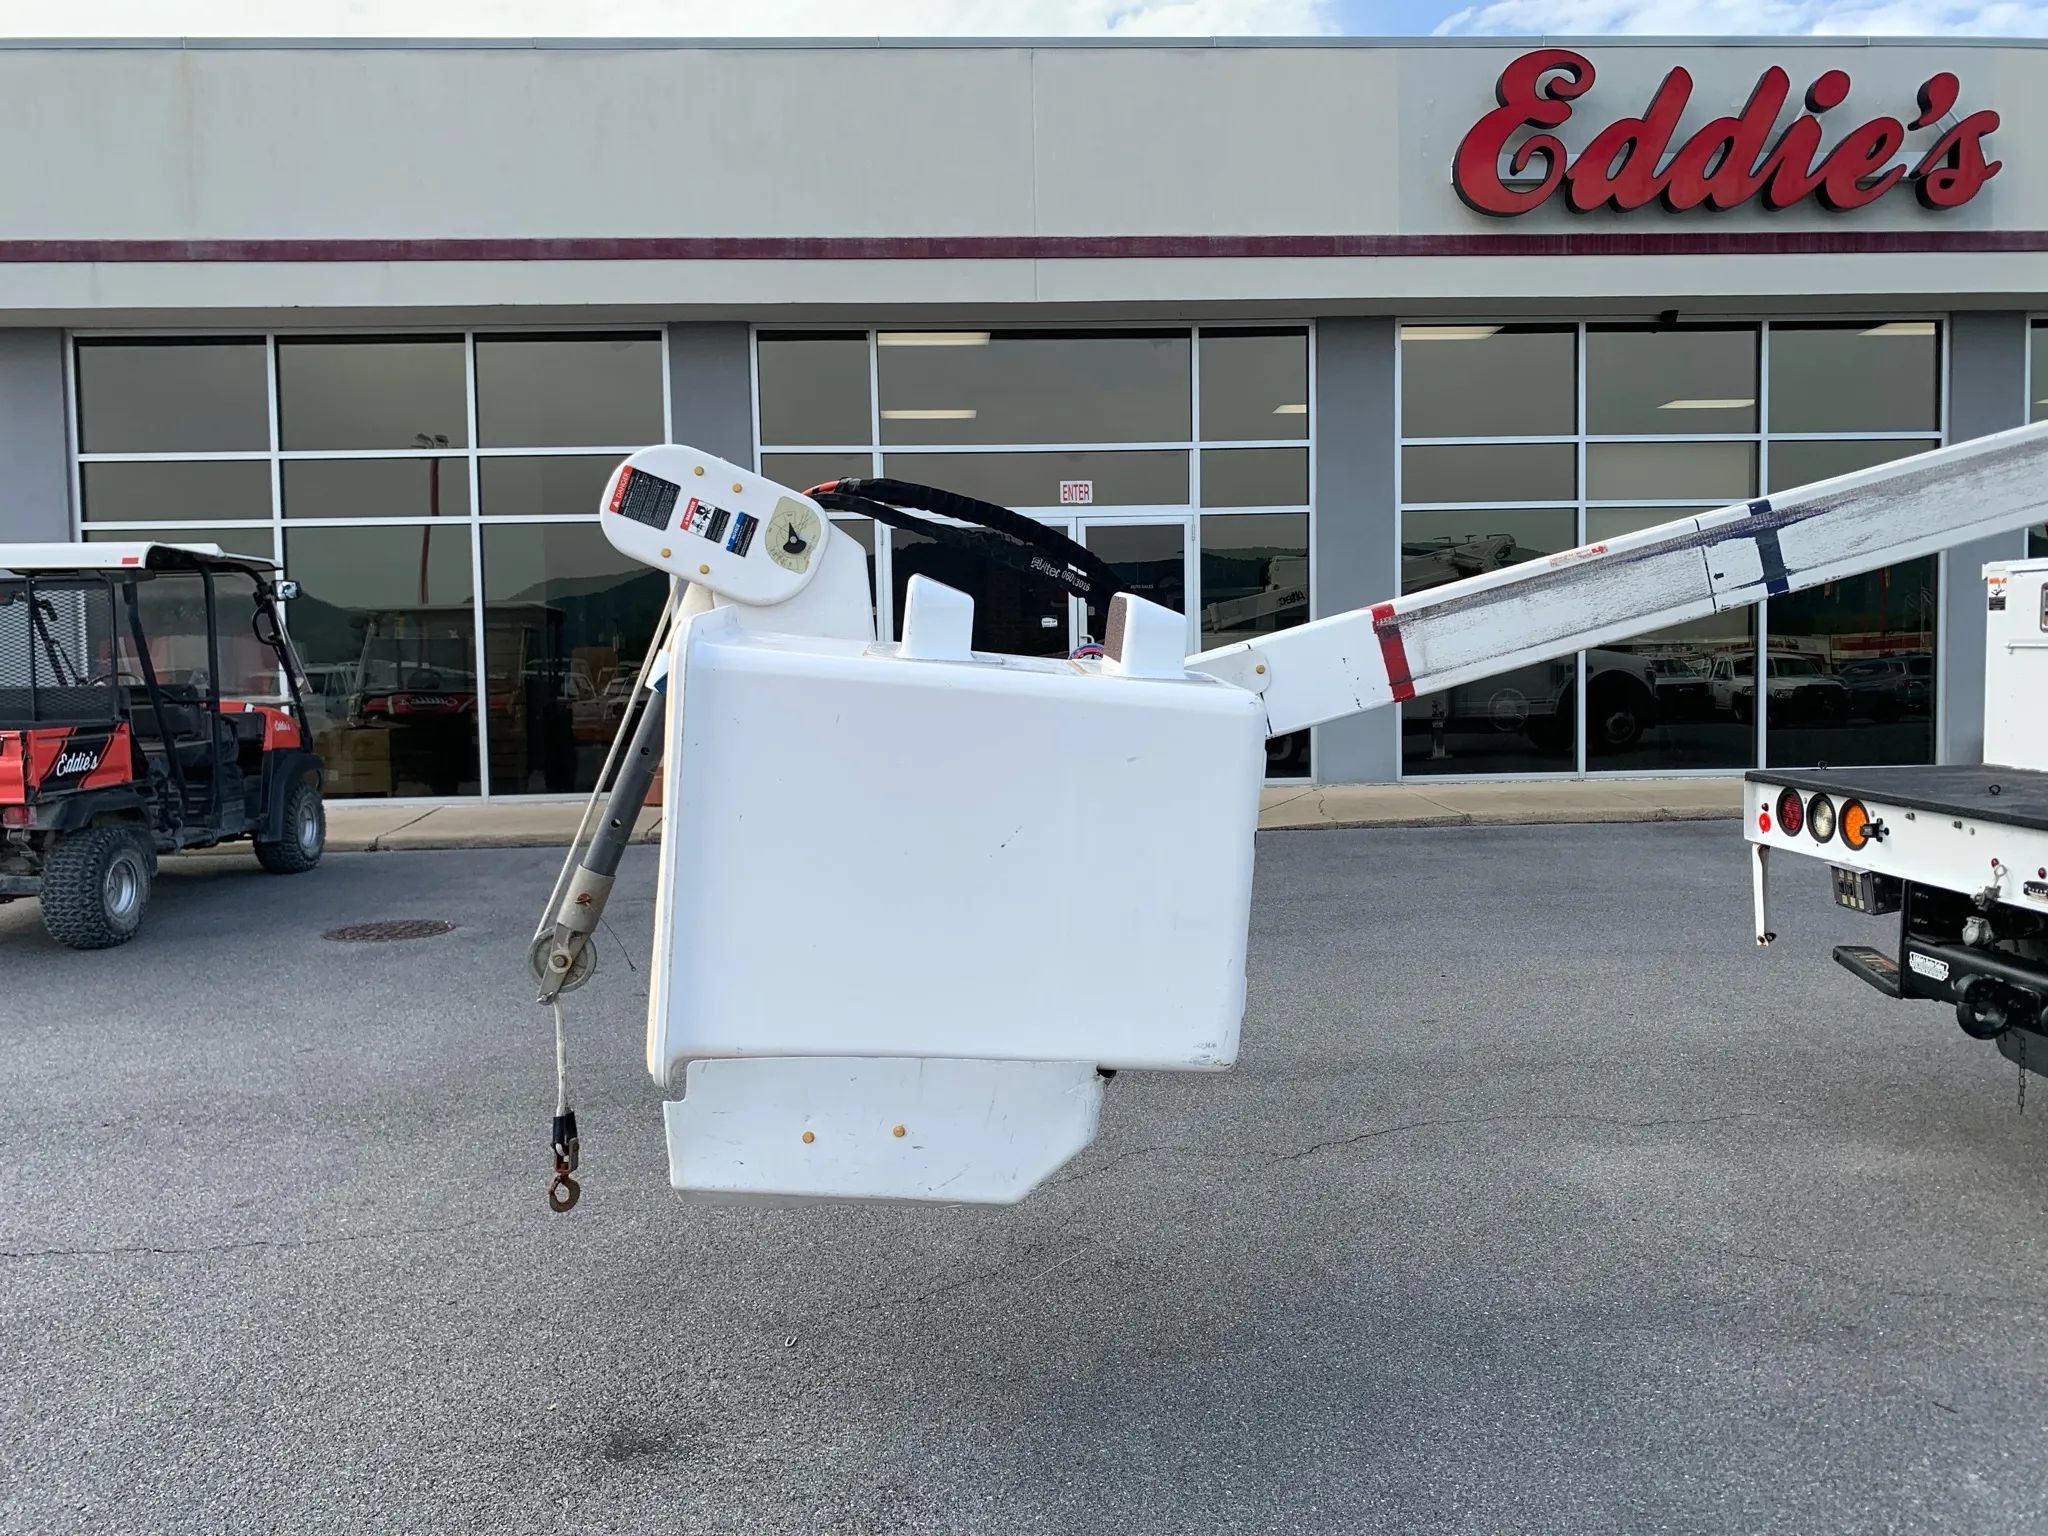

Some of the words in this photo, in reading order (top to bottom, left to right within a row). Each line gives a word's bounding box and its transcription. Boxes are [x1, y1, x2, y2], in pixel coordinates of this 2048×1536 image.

[1453, 49, 2002, 216] Eddie's
[615, 472, 630, 499] DANGER
[1063, 484, 1089, 500] ENTER
[56, 751, 98, 776] Eddie's
